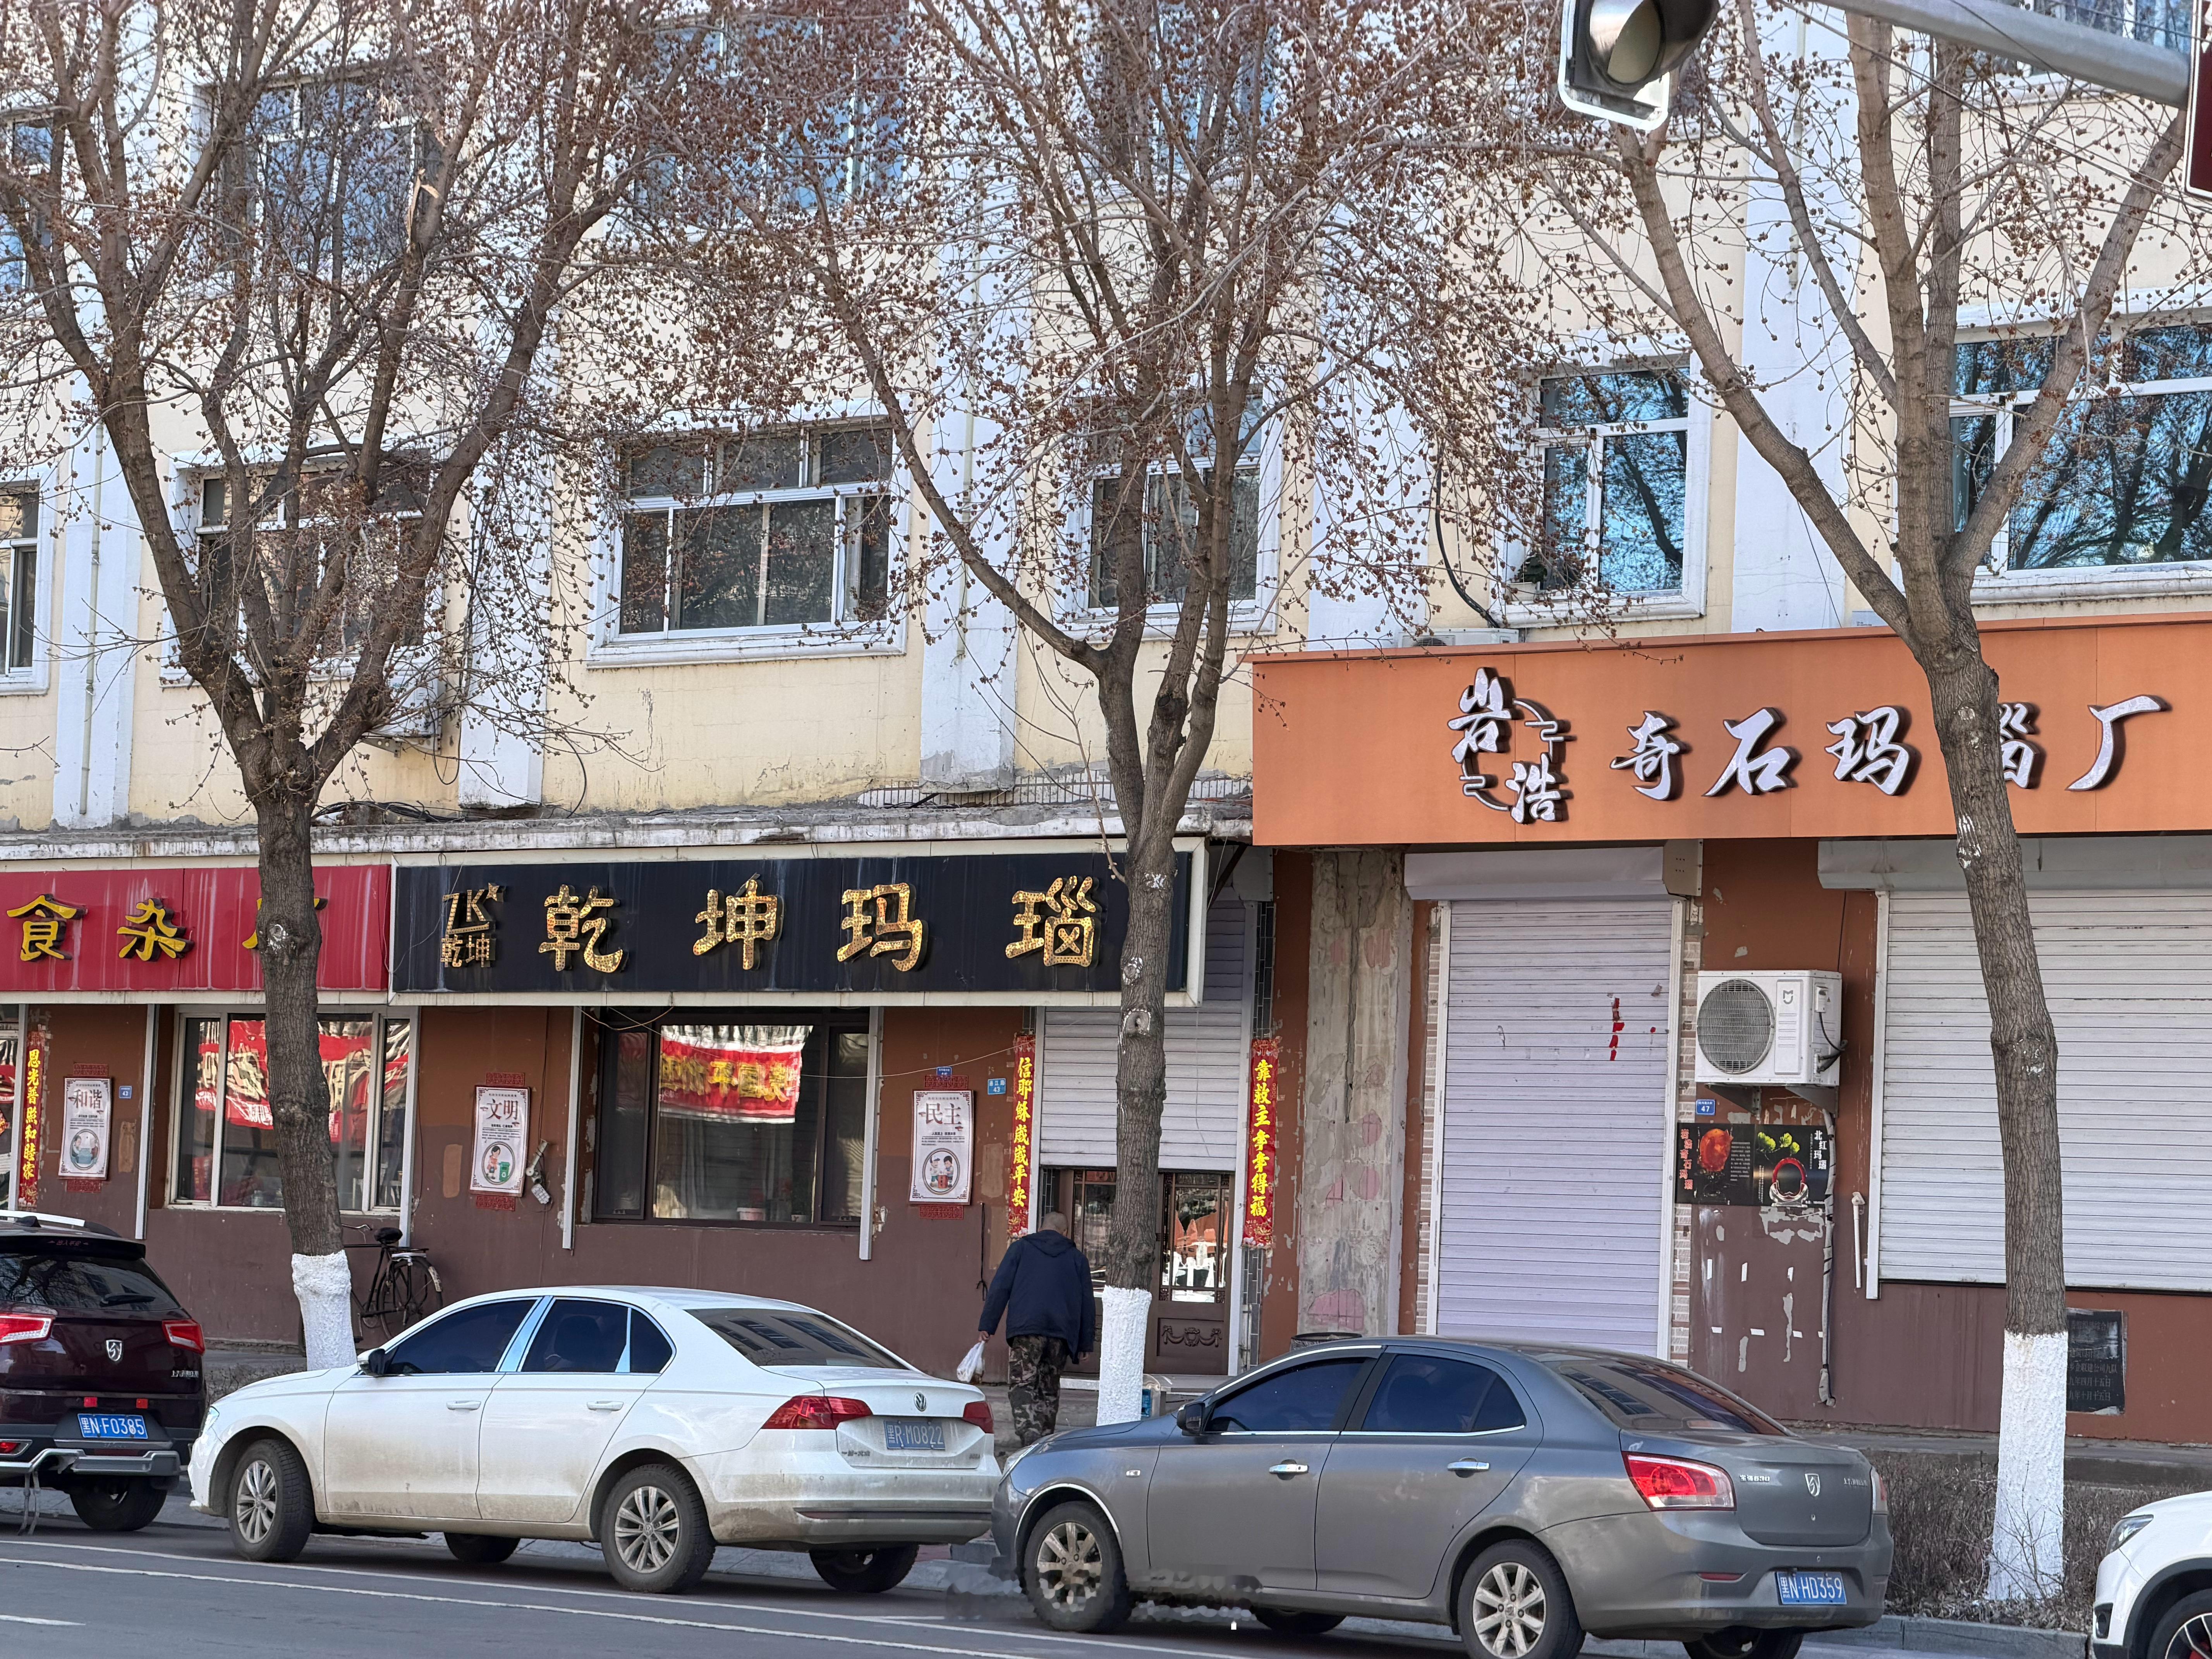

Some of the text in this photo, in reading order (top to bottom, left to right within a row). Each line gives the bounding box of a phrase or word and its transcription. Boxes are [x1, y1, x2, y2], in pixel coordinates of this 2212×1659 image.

[6, 893, 328, 962] 食杂
[539, 876, 1097, 973] 乾坤玛瑙
[440, 933, 490, 967] 乾坤
[22, 1048, 41, 1180] 恩光普照和睦家
[73, 1089, 102, 1109] 和谐
[486, 1098, 519, 1120] 文明
[926, 1103, 962, 1125] 民主
[1814, 1130, 1827, 1170] 北红玛瑙
